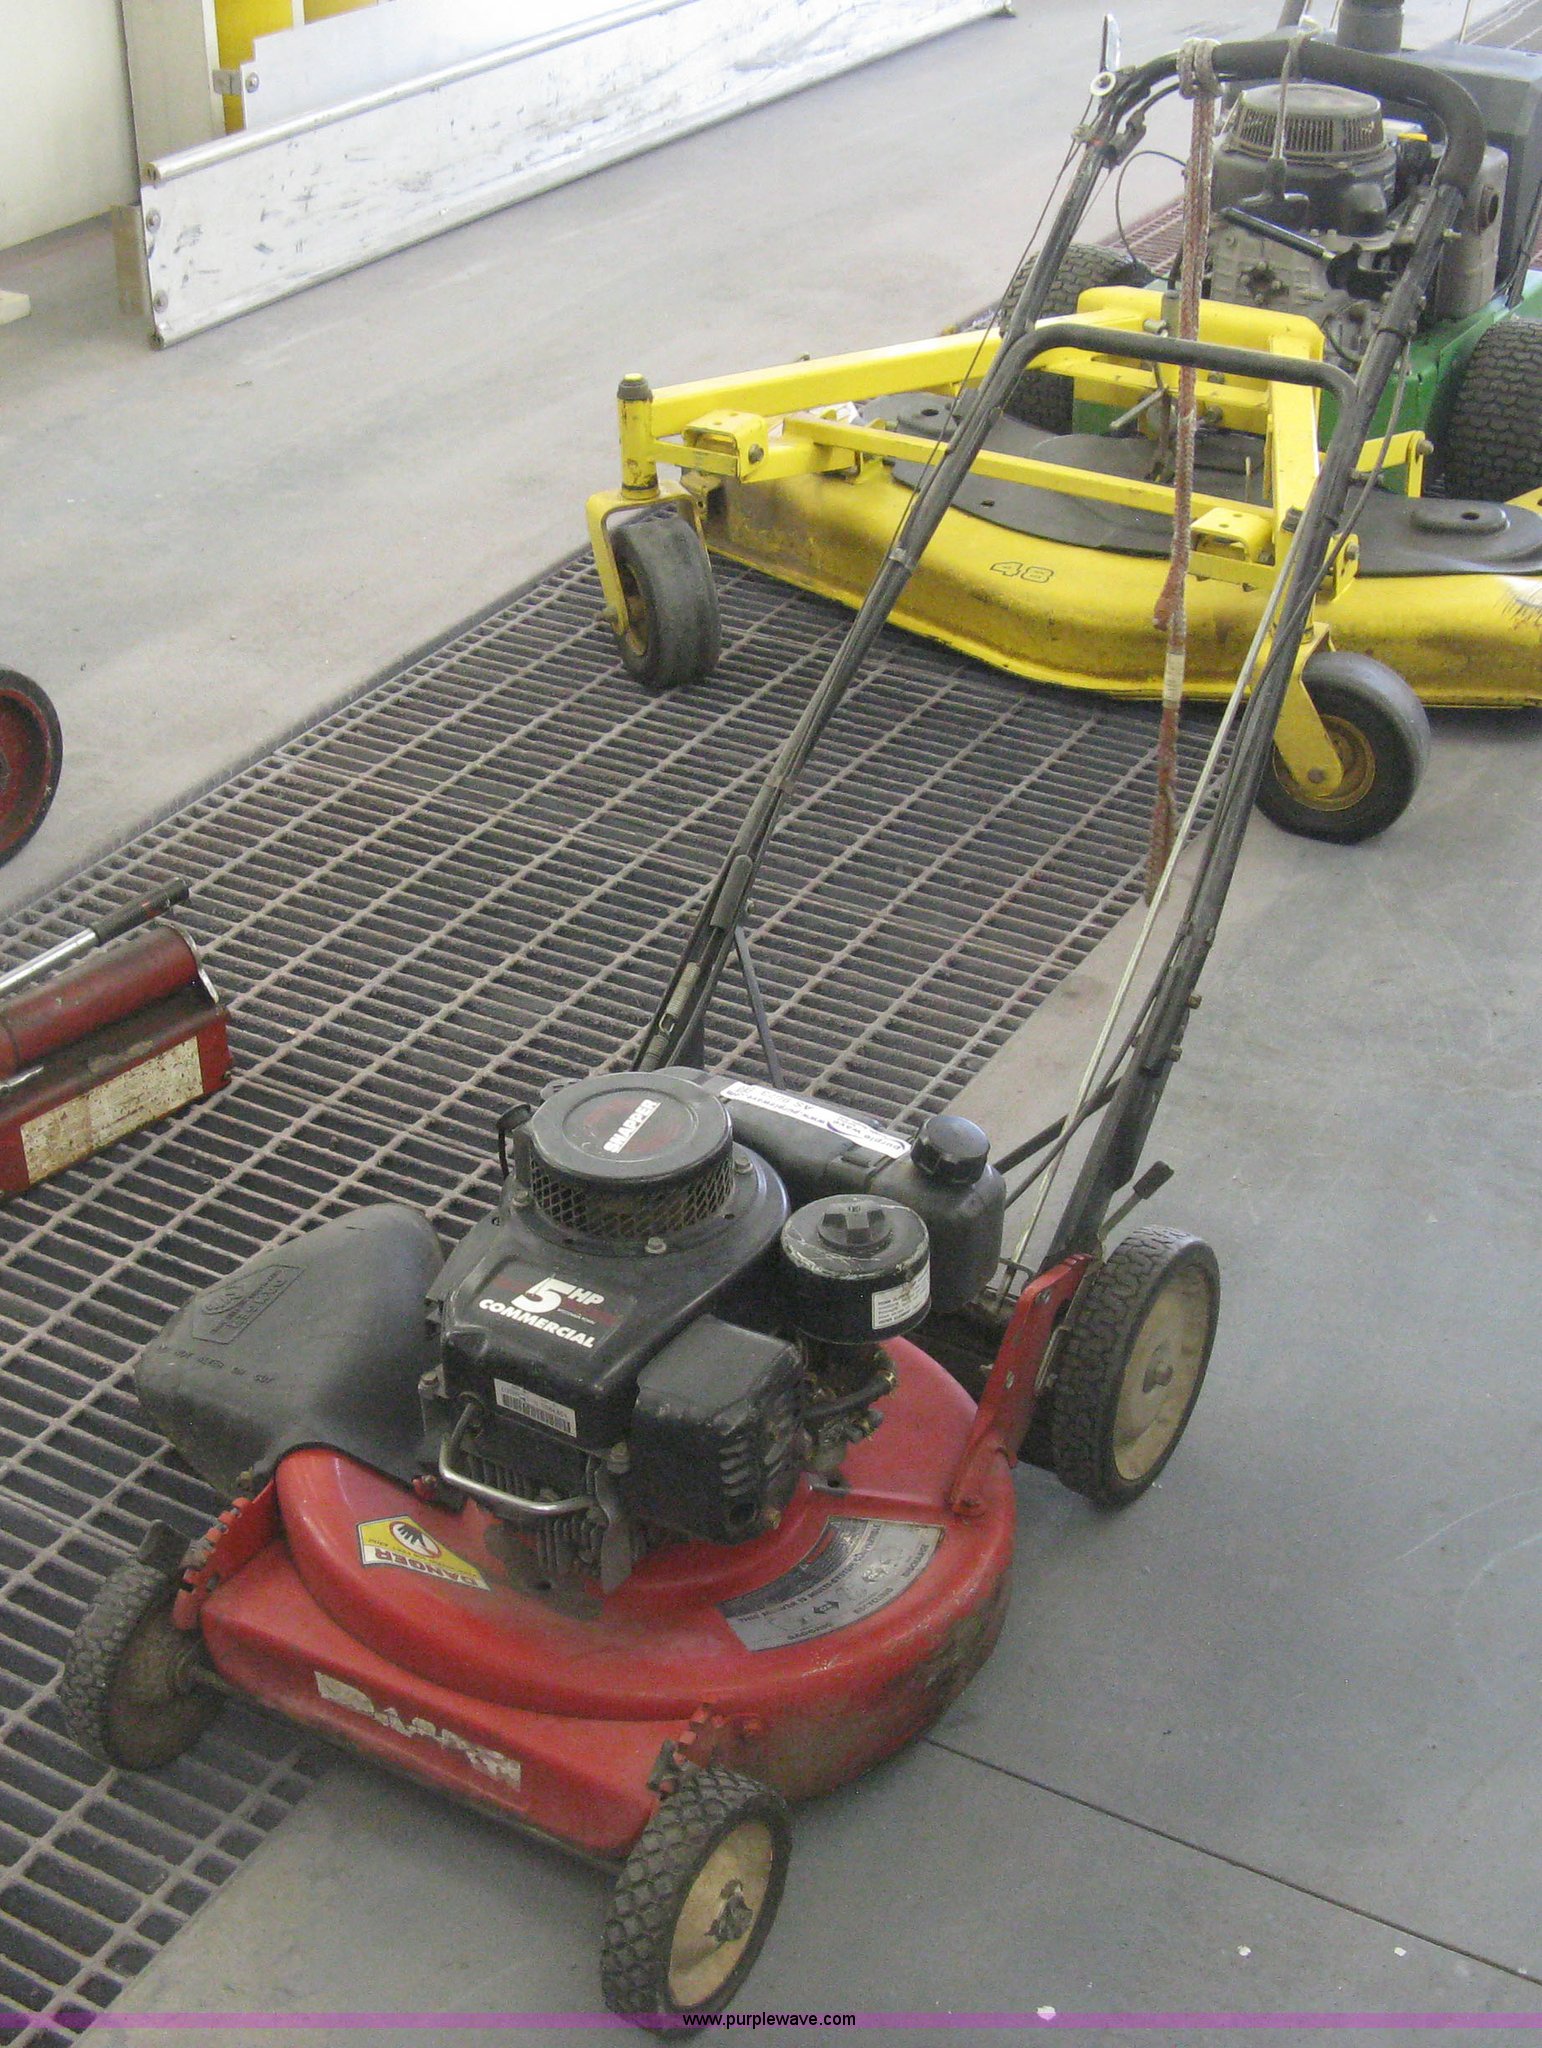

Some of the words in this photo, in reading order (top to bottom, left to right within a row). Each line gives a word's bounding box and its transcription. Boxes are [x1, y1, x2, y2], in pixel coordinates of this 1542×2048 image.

[990, 561, 1054, 584] 48
[602, 1099, 659, 1154] SNAPPER
[510, 1276, 577, 1314] 5
[567, 1287, 605, 1306] HP
[478, 1298, 597, 1349] COMMERCIAL
[374, 1547, 479, 1587] DANGER
